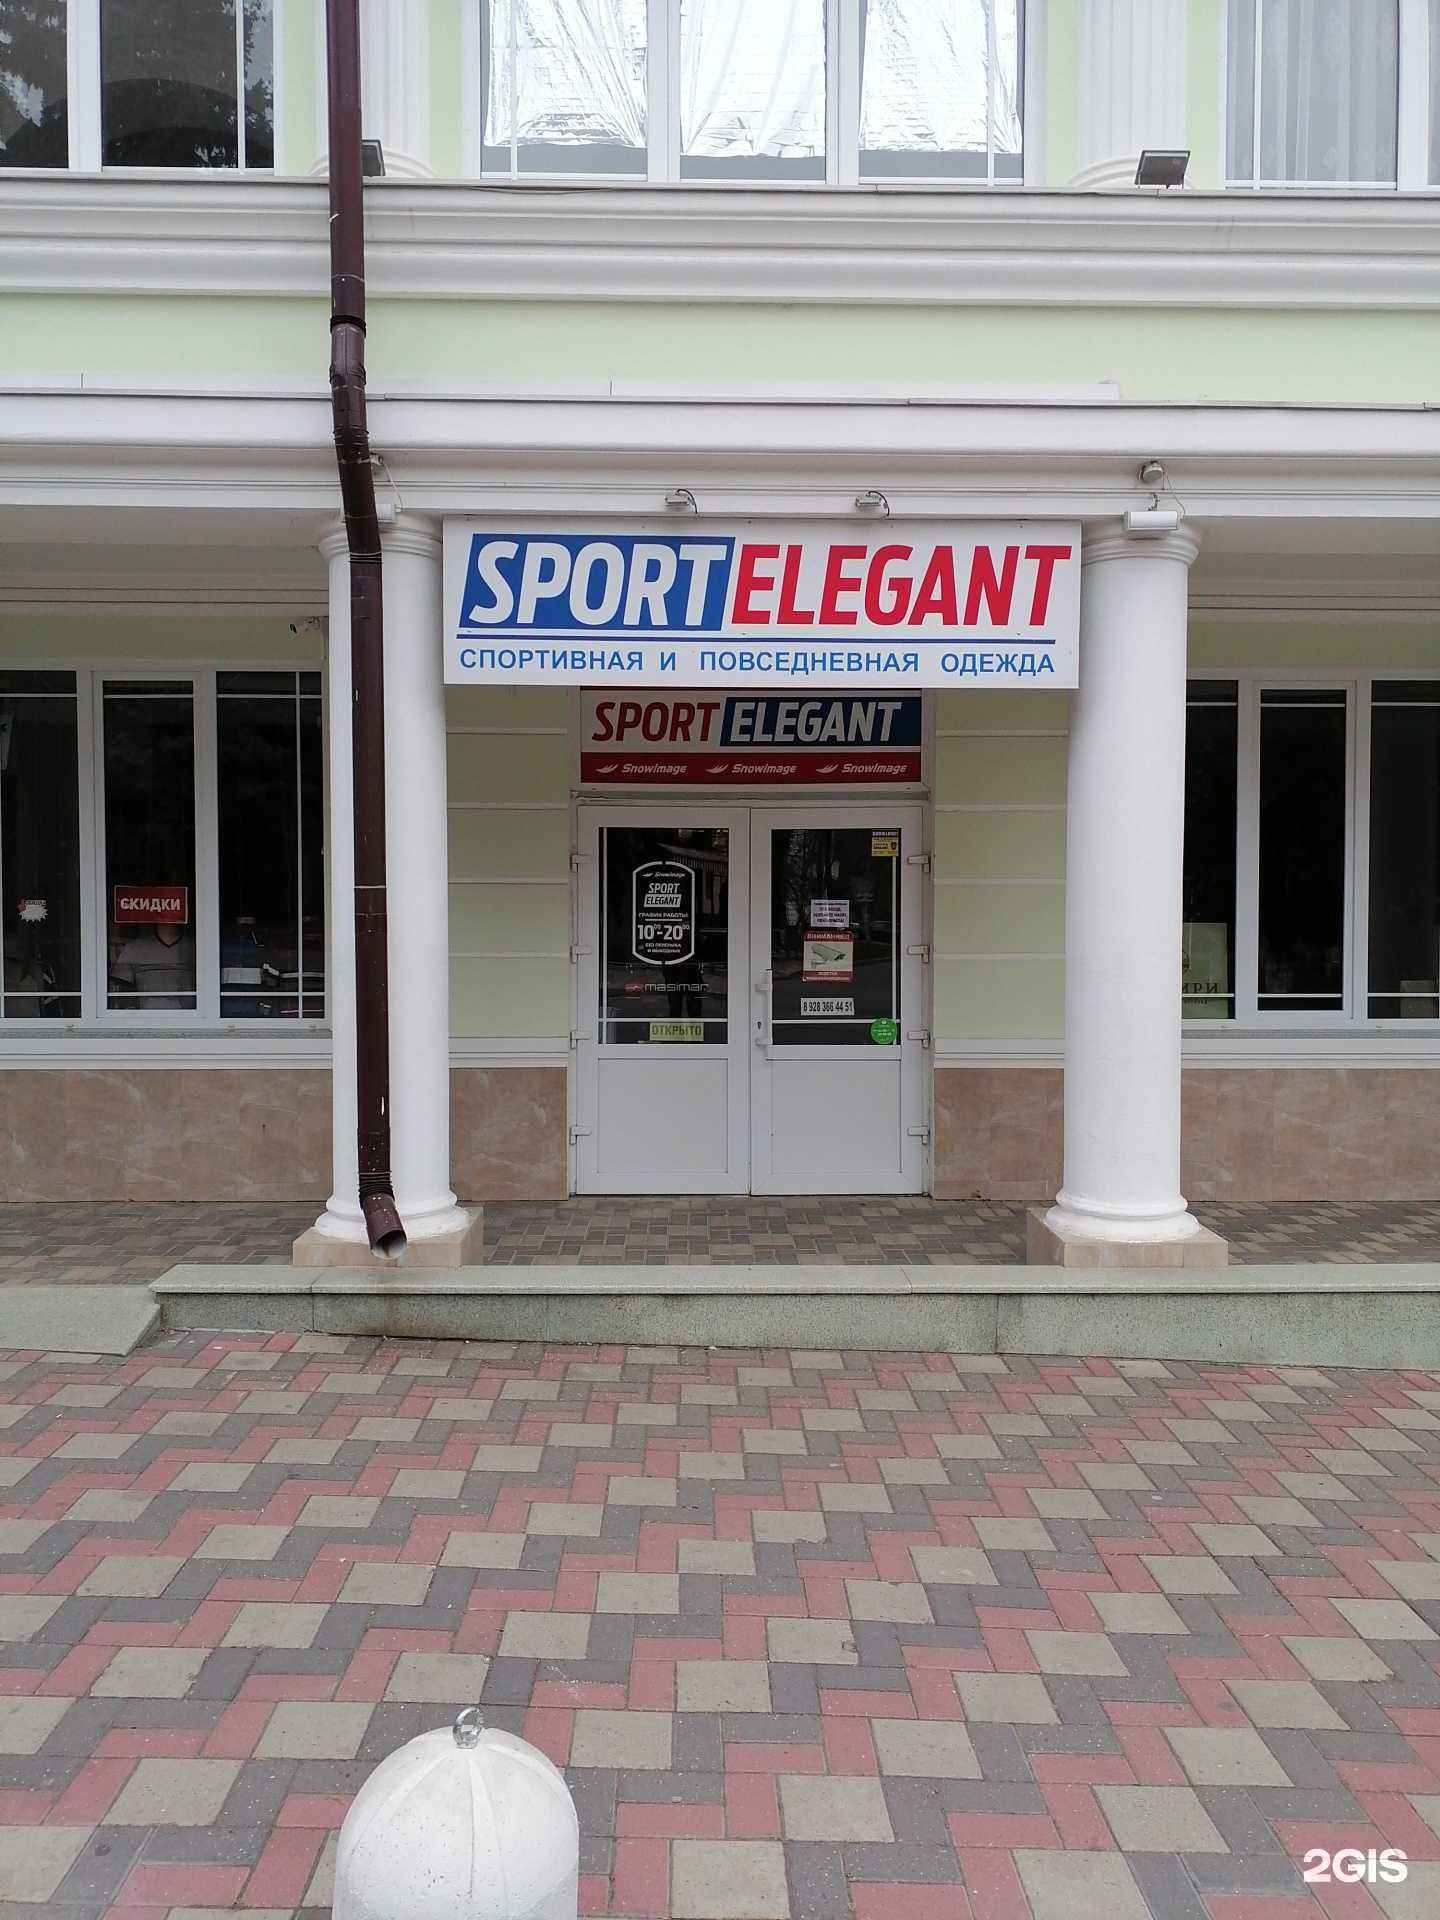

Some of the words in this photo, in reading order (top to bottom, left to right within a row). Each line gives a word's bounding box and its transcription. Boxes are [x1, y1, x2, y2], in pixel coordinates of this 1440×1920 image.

[468, 540, 728, 625] SPORT
[731, 544, 1072, 626] ELEGANT
[460, 649, 643, 670] СПОРТИВНАЯ
[660, 652, 676, 671] И
[700, 651, 919, 675] ПОВСЕДНЕВНАЯ
[940, 653, 1055, 676] ОДЕЖДА
[592, 702, 720, 741] SPORT
[730, 702, 902, 742] ELEGANT
[648, 883, 681, 894] SPORT
[120, 897, 181, 912] СКИДКИ
[803, 1001, 808, 1012] 8
[809, 1001, 821, 1012] 928
[652, 1024, 702, 1036] ОТКРЫТО
